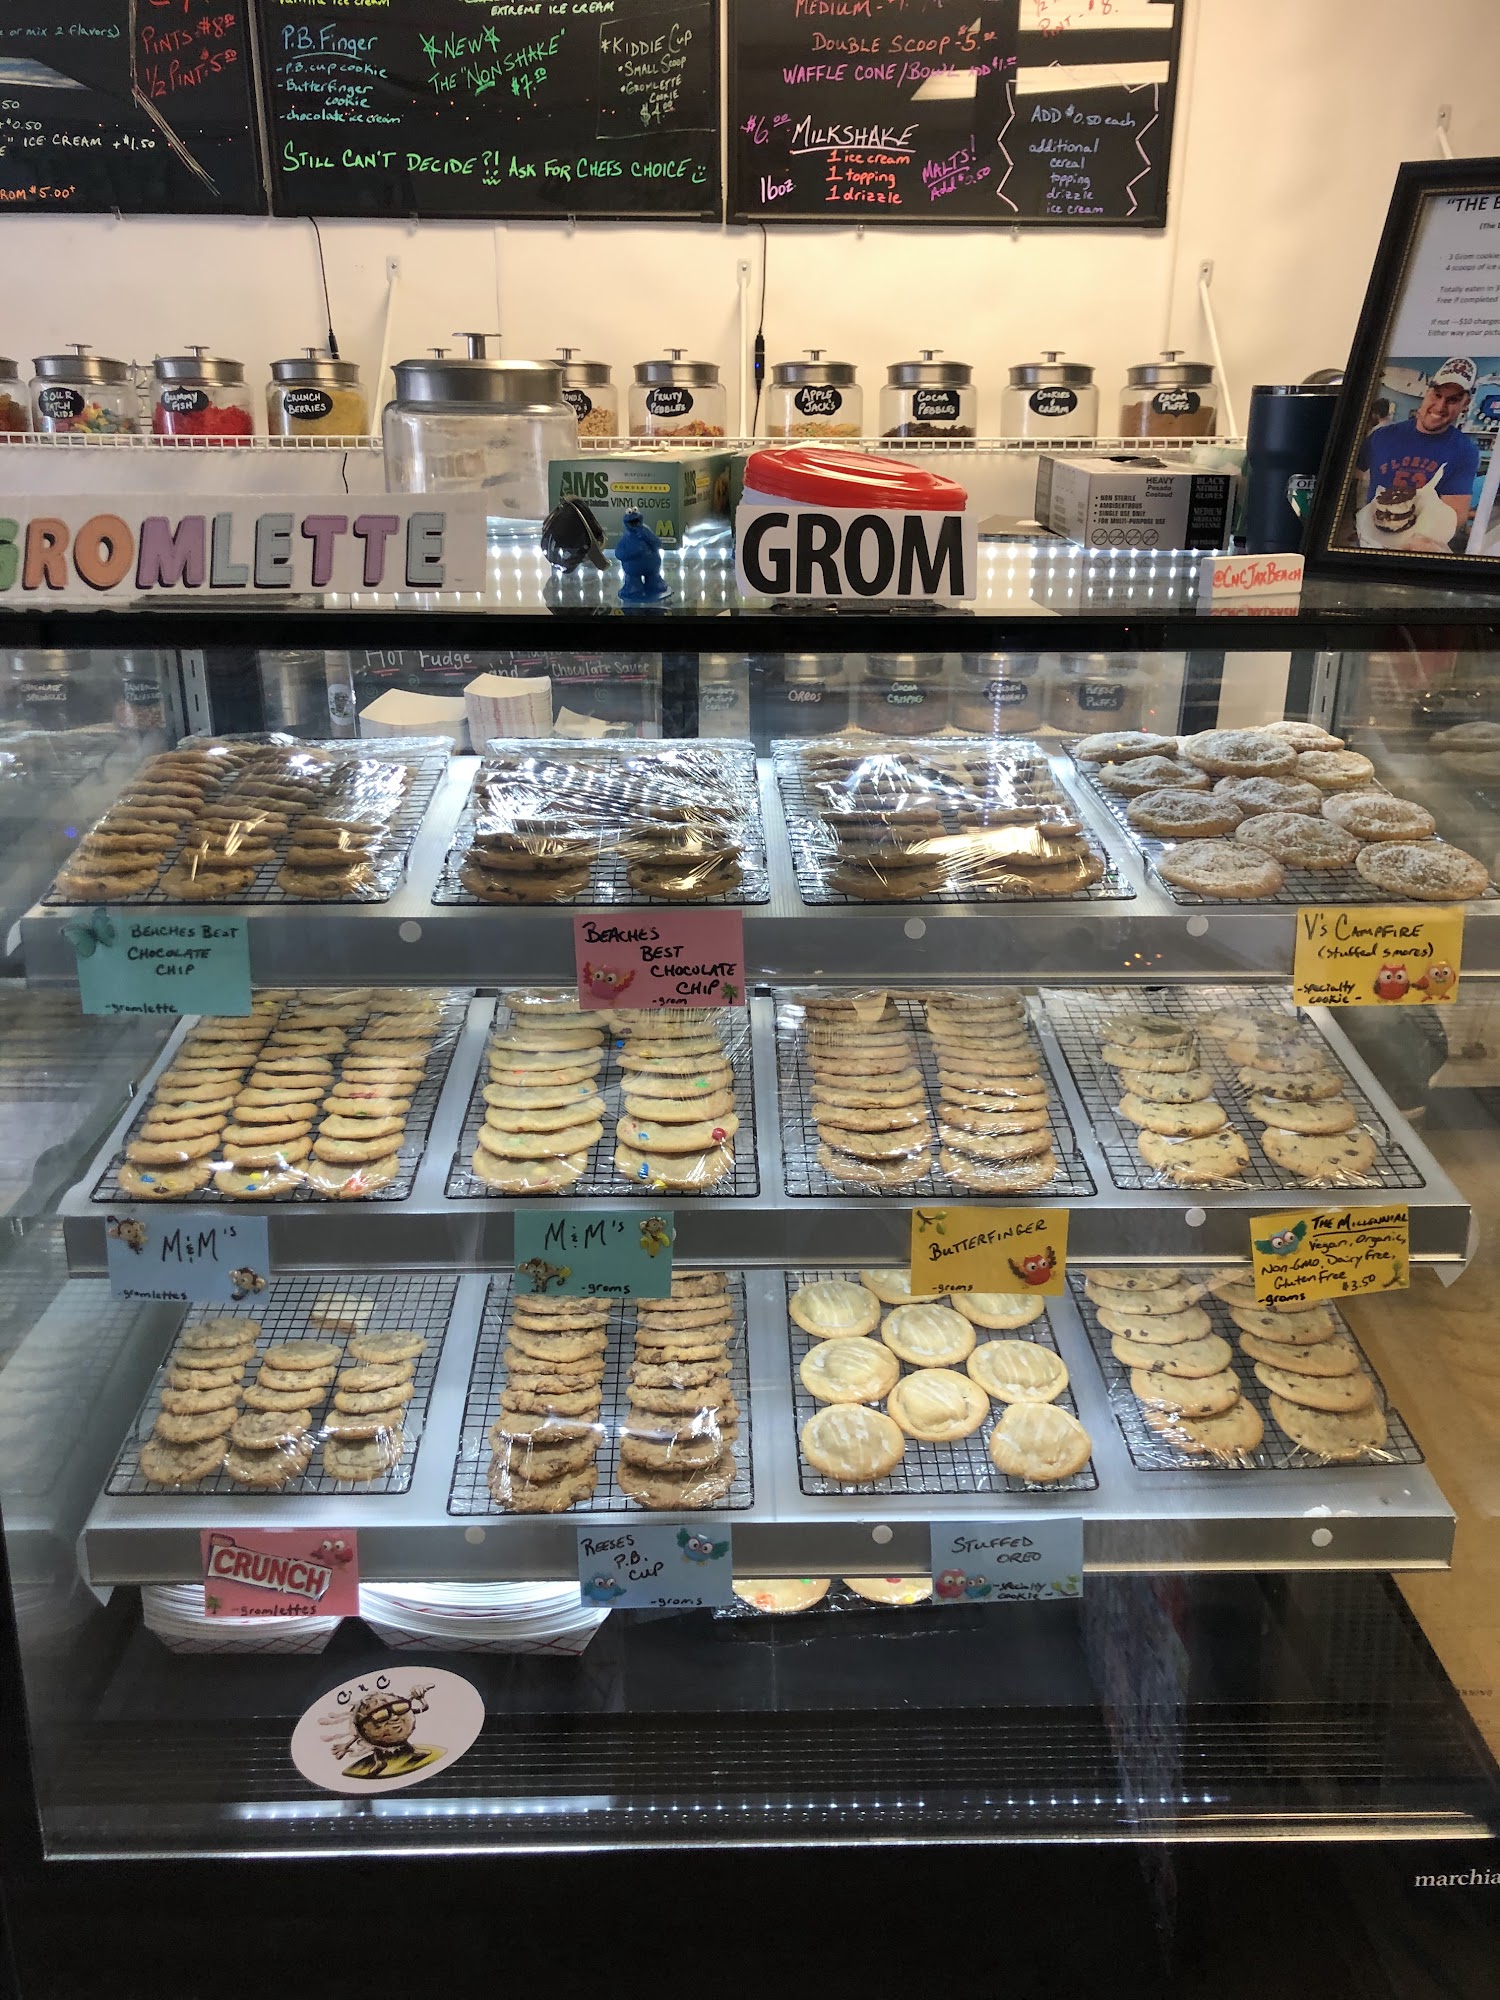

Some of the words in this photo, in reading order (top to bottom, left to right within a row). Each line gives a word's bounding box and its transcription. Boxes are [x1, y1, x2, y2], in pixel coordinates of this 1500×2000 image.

[491, 5, 542, 16] EXTREME
[549, 3, 568, 14] ICE
[572, 1, 615, 14] CREAM
[10, 28, 22, 36] or
[26, 27, 48, 36] mix
[69, 23, 120, 38] flavors)
[812, 32, 881, 54] DOUBLE
[888, 35, 951, 55] SCOOP
[310, 64, 337, 75] cup
[340, 64, 388, 79] cookie
[783, 63, 848, 84] WAFFLE
[325, 97, 371, 108] cookie
[366, 113, 400, 124] cream
[1030, 105, 1061, 123] ADD
[1105, 112, 1136, 127] each
[792, 115, 919, 147] MILKSHAKE
[24, 136, 45, 147] ICE
[52, 134, 101, 147] CREAM
[1029, 138, 1100, 153] additional
[283, 140, 335, 172] STILL
[342, 149, 396, 168] CAN'T
[407, 154, 476, 175] DECIDE
[545, 159, 571, 182] FOR
[576, 157, 623, 178] CHEFS
[631, 157, 692, 178] CHOICE
[827, 150, 841, 163] 1
[844, 151, 864, 164] ice
[867, 154, 910, 165] cream
[1050, 157, 1085, 169] cereal
[826, 166, 843, 182] 1
[845, 169, 896, 189] topping
[1050, 172, 1091, 189] topping
[825, 185, 841, 201] 1
[843, 187, 902, 205] drizzle
[1046, 188, 1094, 200] drizzle
[1047, 204, 1063, 213] ice
[1067, 205, 1103, 214] cream
[43, 391, 74, 401] SOUR
[286, 393, 320, 402] CRUNCH
[653, 389, 683, 403] FRUITY
[801, 388, 834, 402] APPLE
[172, 401, 193, 411] FISH
[288, 403, 327, 414] BERRIES
[650, 402, 686, 414] PEBBLES
[918, 402, 956, 415] PEBBLES
[53, 410, 74, 418] KIDS
[1196, 476, 1225, 485] BLACK
[610, 497, 635, 508] VINYL
[637, 498, 671, 509] GLOVES
[1195, 492, 1224, 500] GLOVES
[742, 513, 966, 597] GROM
[552, 661, 611, 677] Chocolate
[131, 925, 196, 938] BEACHES
[202, 925, 239, 939] BEST
[582, 921, 660, 943] BEACHES
[1335, 913, 1424, 941] CAMPFIRE
[127, 947, 211, 960] CHOCOLATE
[640, 945, 684, 962] BEST
[156, 964, 195, 976] CHIP
[650, 963, 737, 978] CHOCOLATE
[676, 979, 720, 995] CHIP
[1312, 1215, 1333, 1230] THE
[929, 1219, 1047, 1262] BUTTERFINGER
[1327, 1253, 1362, 1269] Dairy
[1274, 1275, 1316, 1290] Gluten
[1319, 1270, 1347, 1284] Free
[580, 1534, 635, 1557] REESES
[951, 1536, 1033, 1554] STUFFED
[613, 1551, 648, 1570] P.B.
[997, 1552, 1042, 1564] OREO
[213, 1548, 327, 1595] CRUNCH
[1414, 1868, 1500, 1887] marchia
